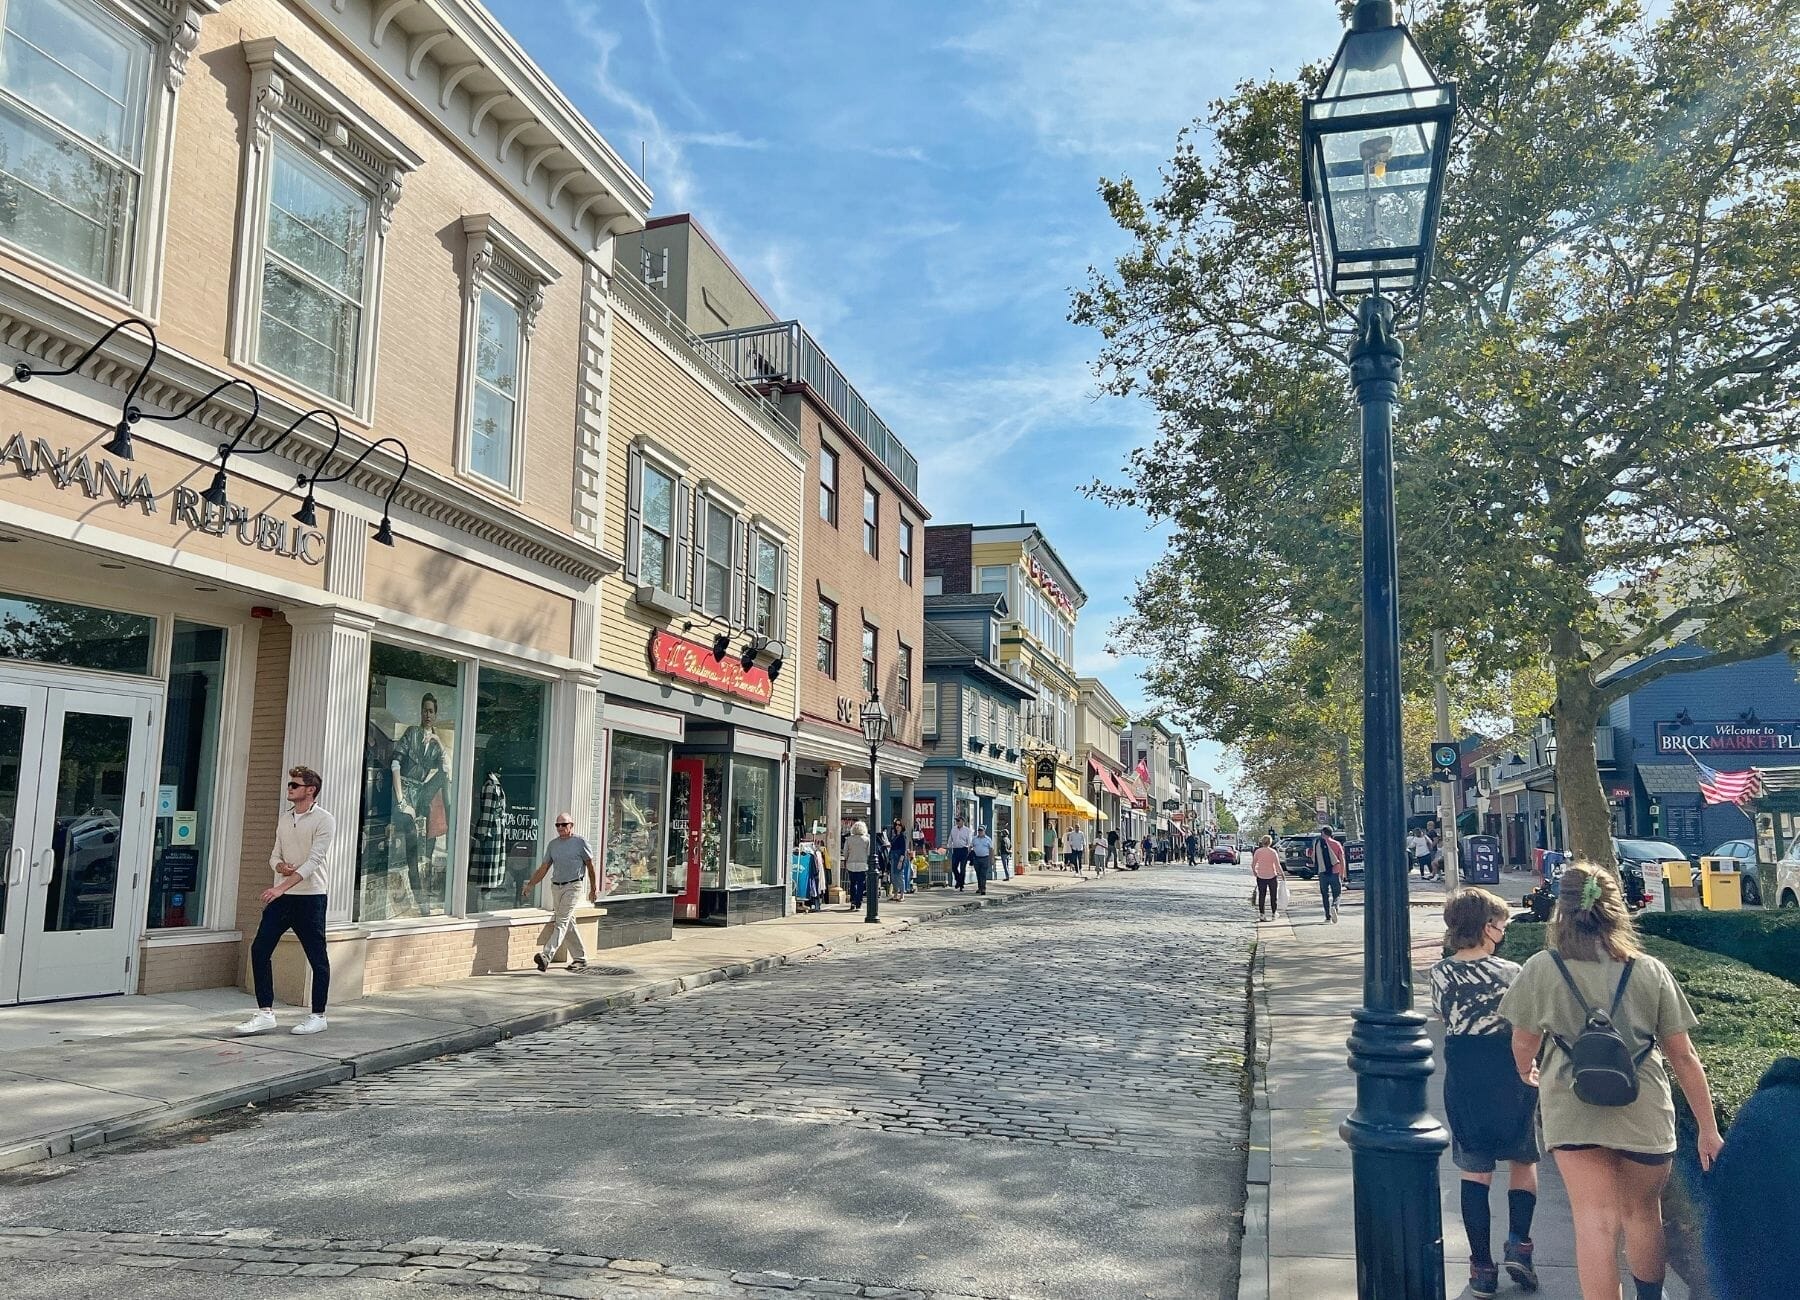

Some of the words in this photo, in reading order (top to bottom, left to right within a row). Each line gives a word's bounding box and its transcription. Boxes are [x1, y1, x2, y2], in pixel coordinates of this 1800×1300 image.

[1715, 724, 1761, 735] Welcome
[1764, 726, 1775, 735] to
[914, 803, 935, 815] ART
[517, 814, 530, 826] OFF
[674, 821, 690, 829] OPEN
[915, 817, 935, 829] SALE
